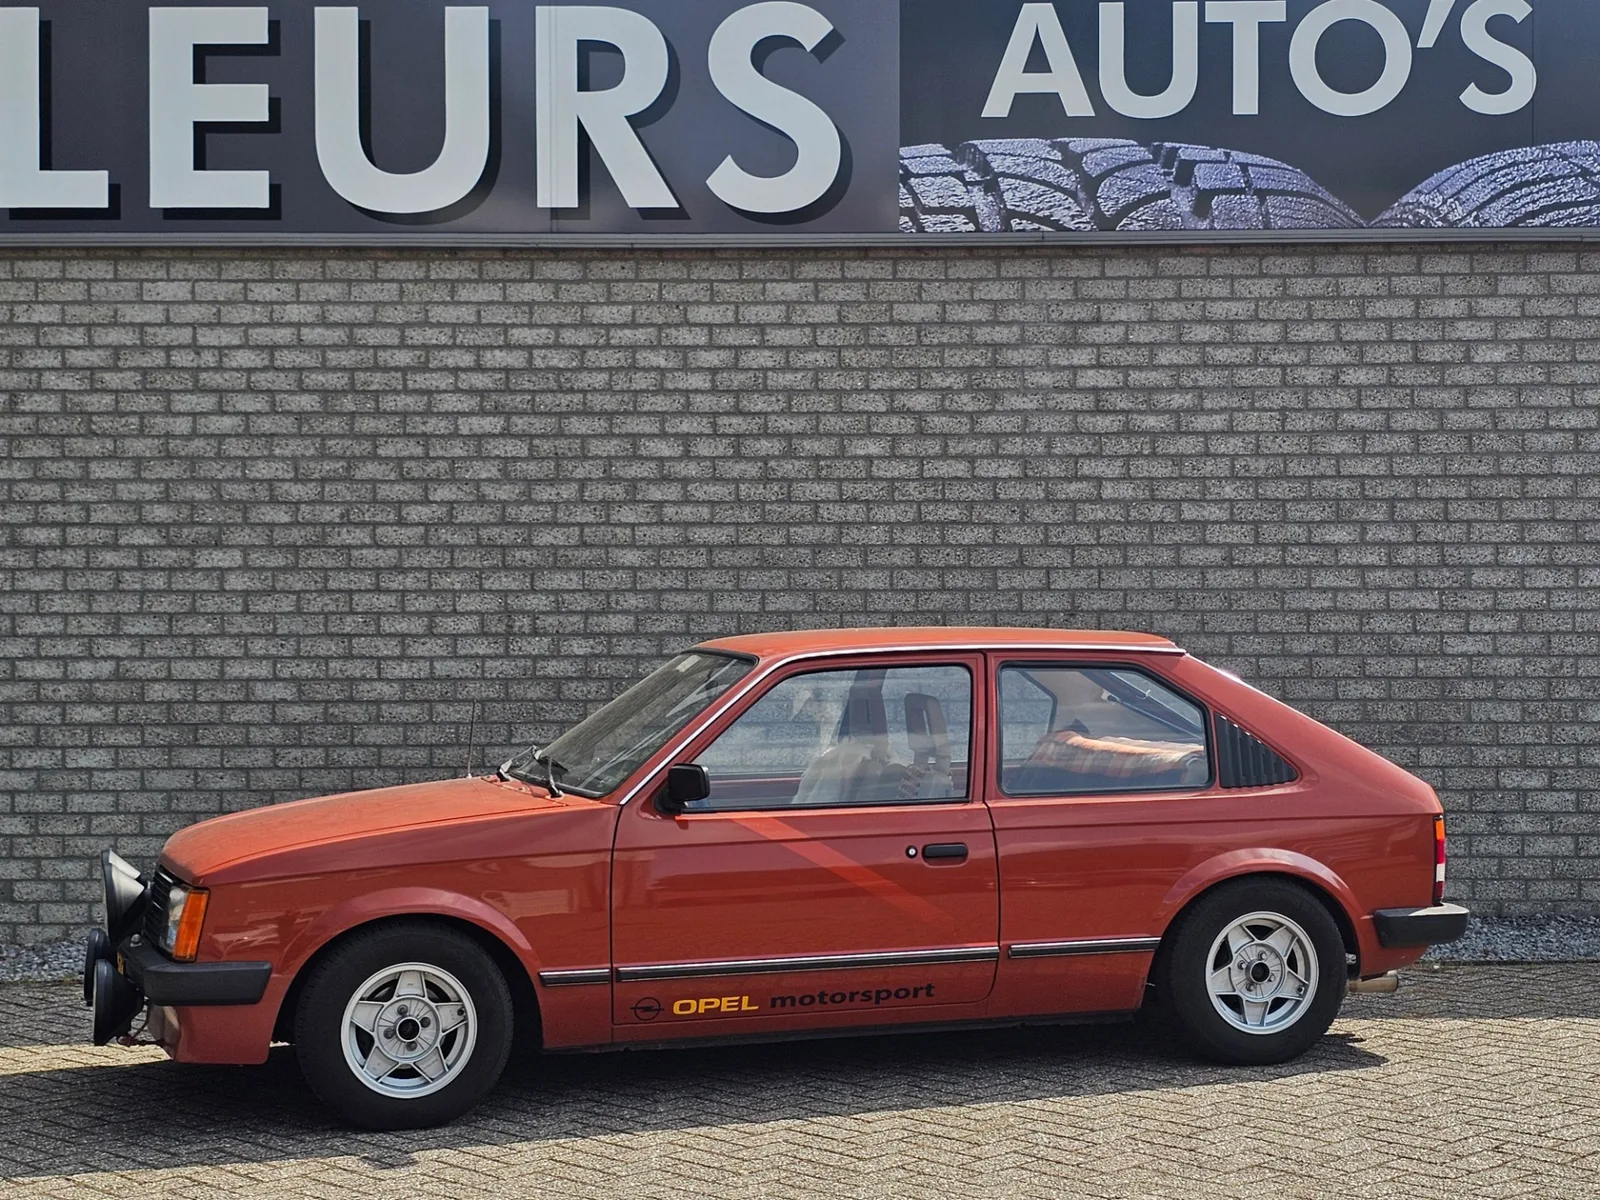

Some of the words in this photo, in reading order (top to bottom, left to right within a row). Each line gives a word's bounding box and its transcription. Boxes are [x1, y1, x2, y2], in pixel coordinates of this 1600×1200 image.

[0, 1, 842, 213] LEURS
[981, 0, 1537, 118] AUTO'S
[672, 995, 759, 1015] OPEL
[770, 983, 936, 1009] motorsport
